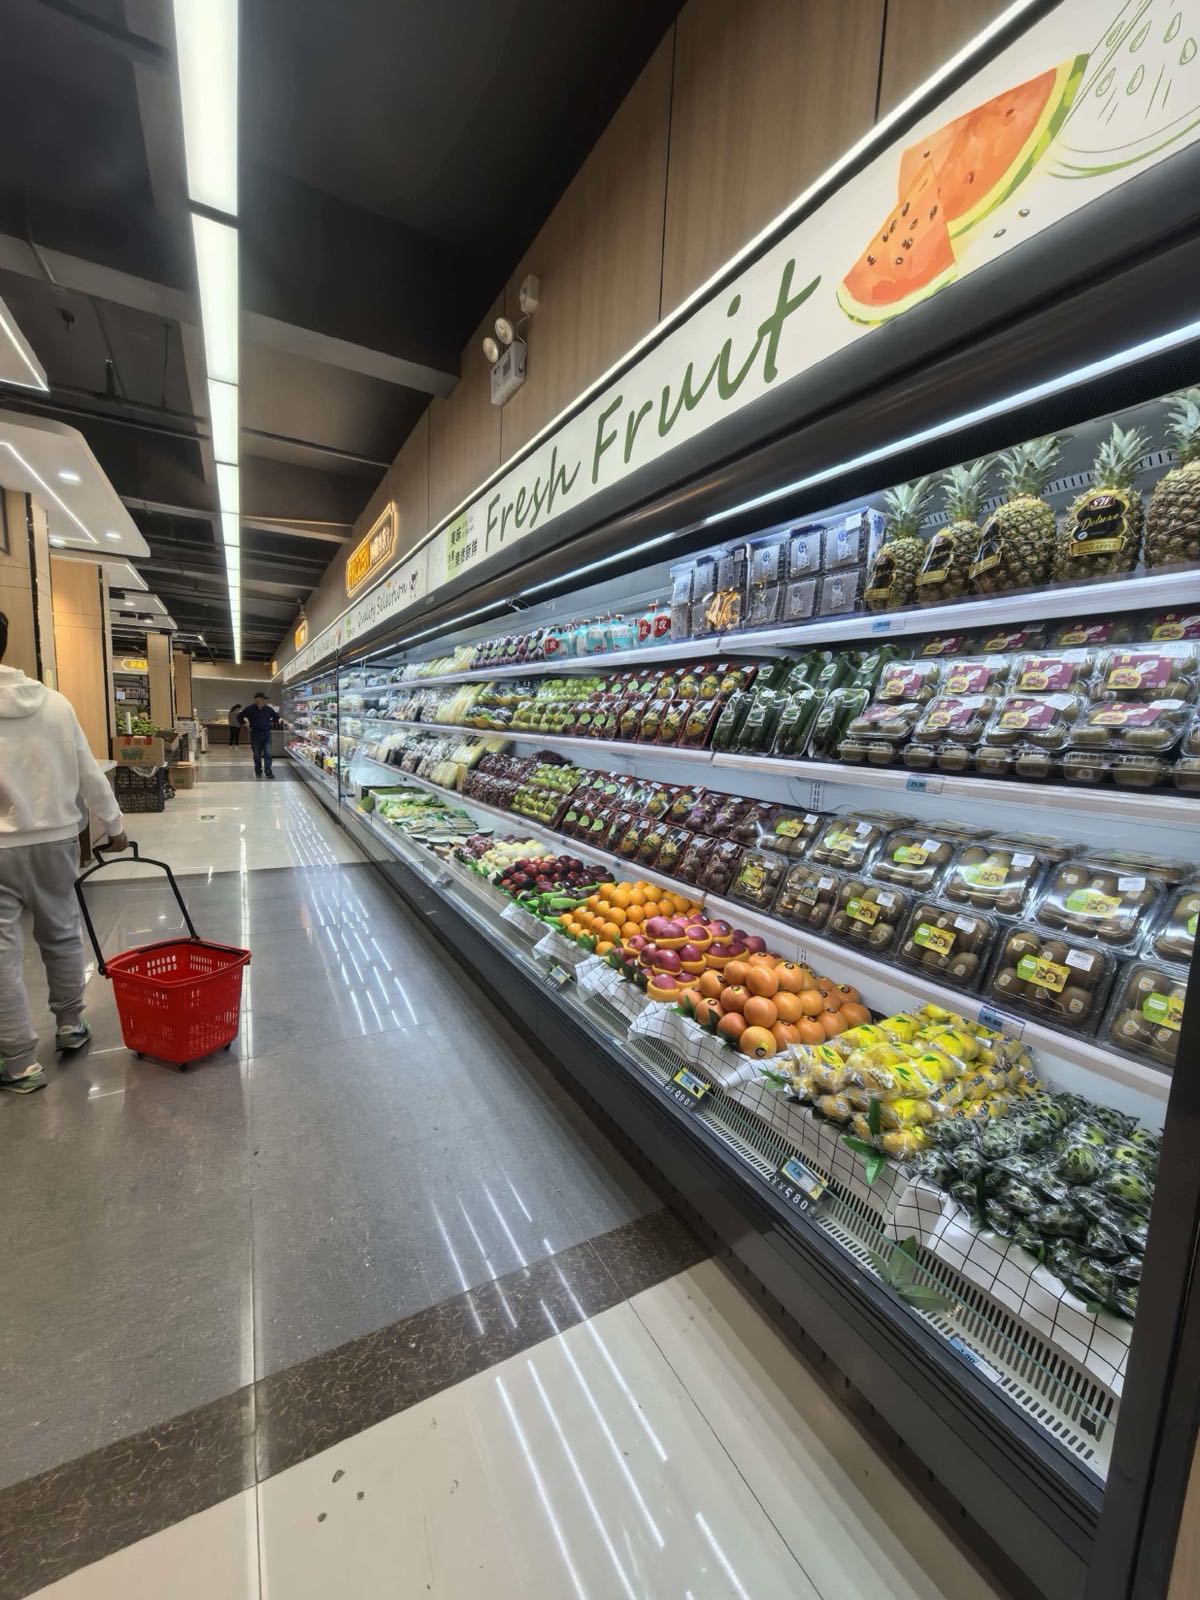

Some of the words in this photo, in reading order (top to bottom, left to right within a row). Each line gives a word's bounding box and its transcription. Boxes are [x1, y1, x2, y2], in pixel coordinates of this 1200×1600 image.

[485, 446, 582, 552] Fresh
[592, 258, 822, 484] Fruit
[377, 581, 408, 615] Selection
